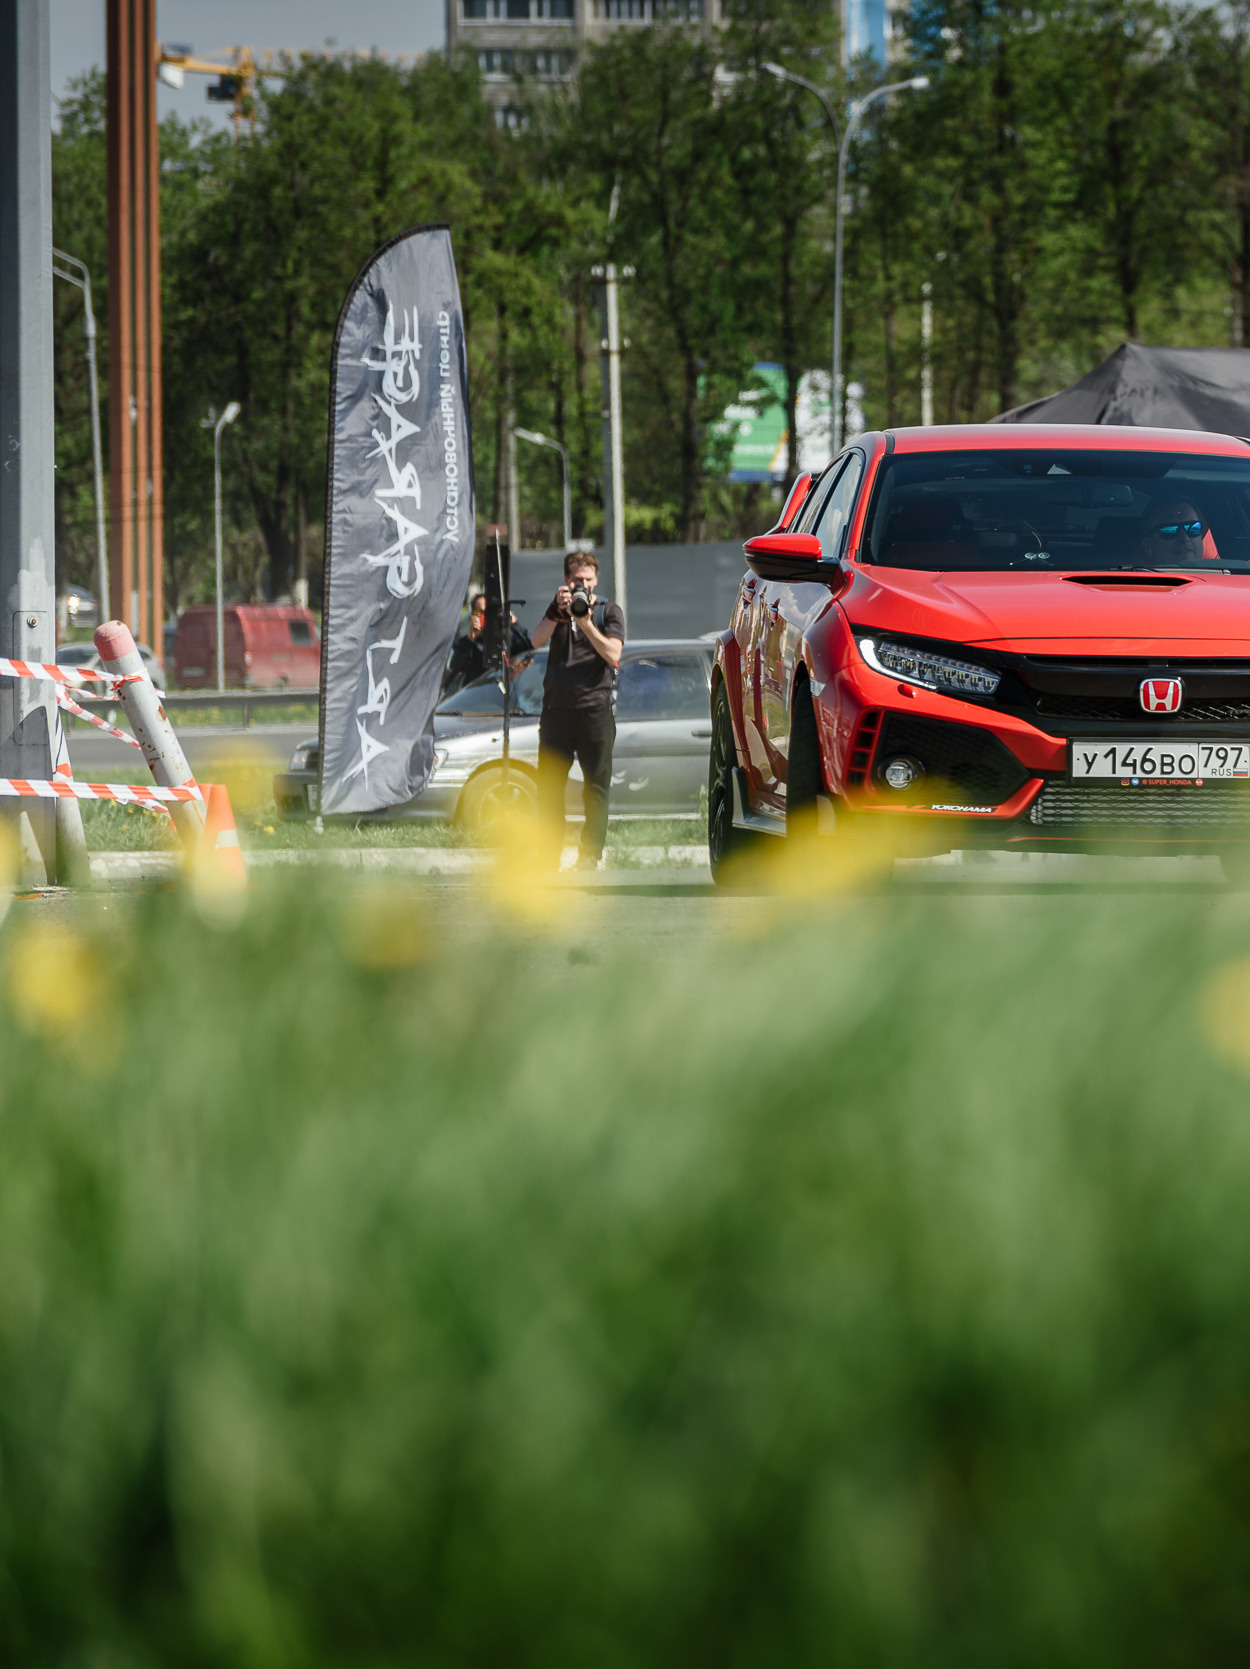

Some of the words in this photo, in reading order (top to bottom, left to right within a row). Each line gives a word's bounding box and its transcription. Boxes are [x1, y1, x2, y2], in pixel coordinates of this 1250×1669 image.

[1201, 746, 1243, 768] 797
[1211, 768, 1232, 776] RUS
[931, 804, 992, 813] YOKOHAMA
